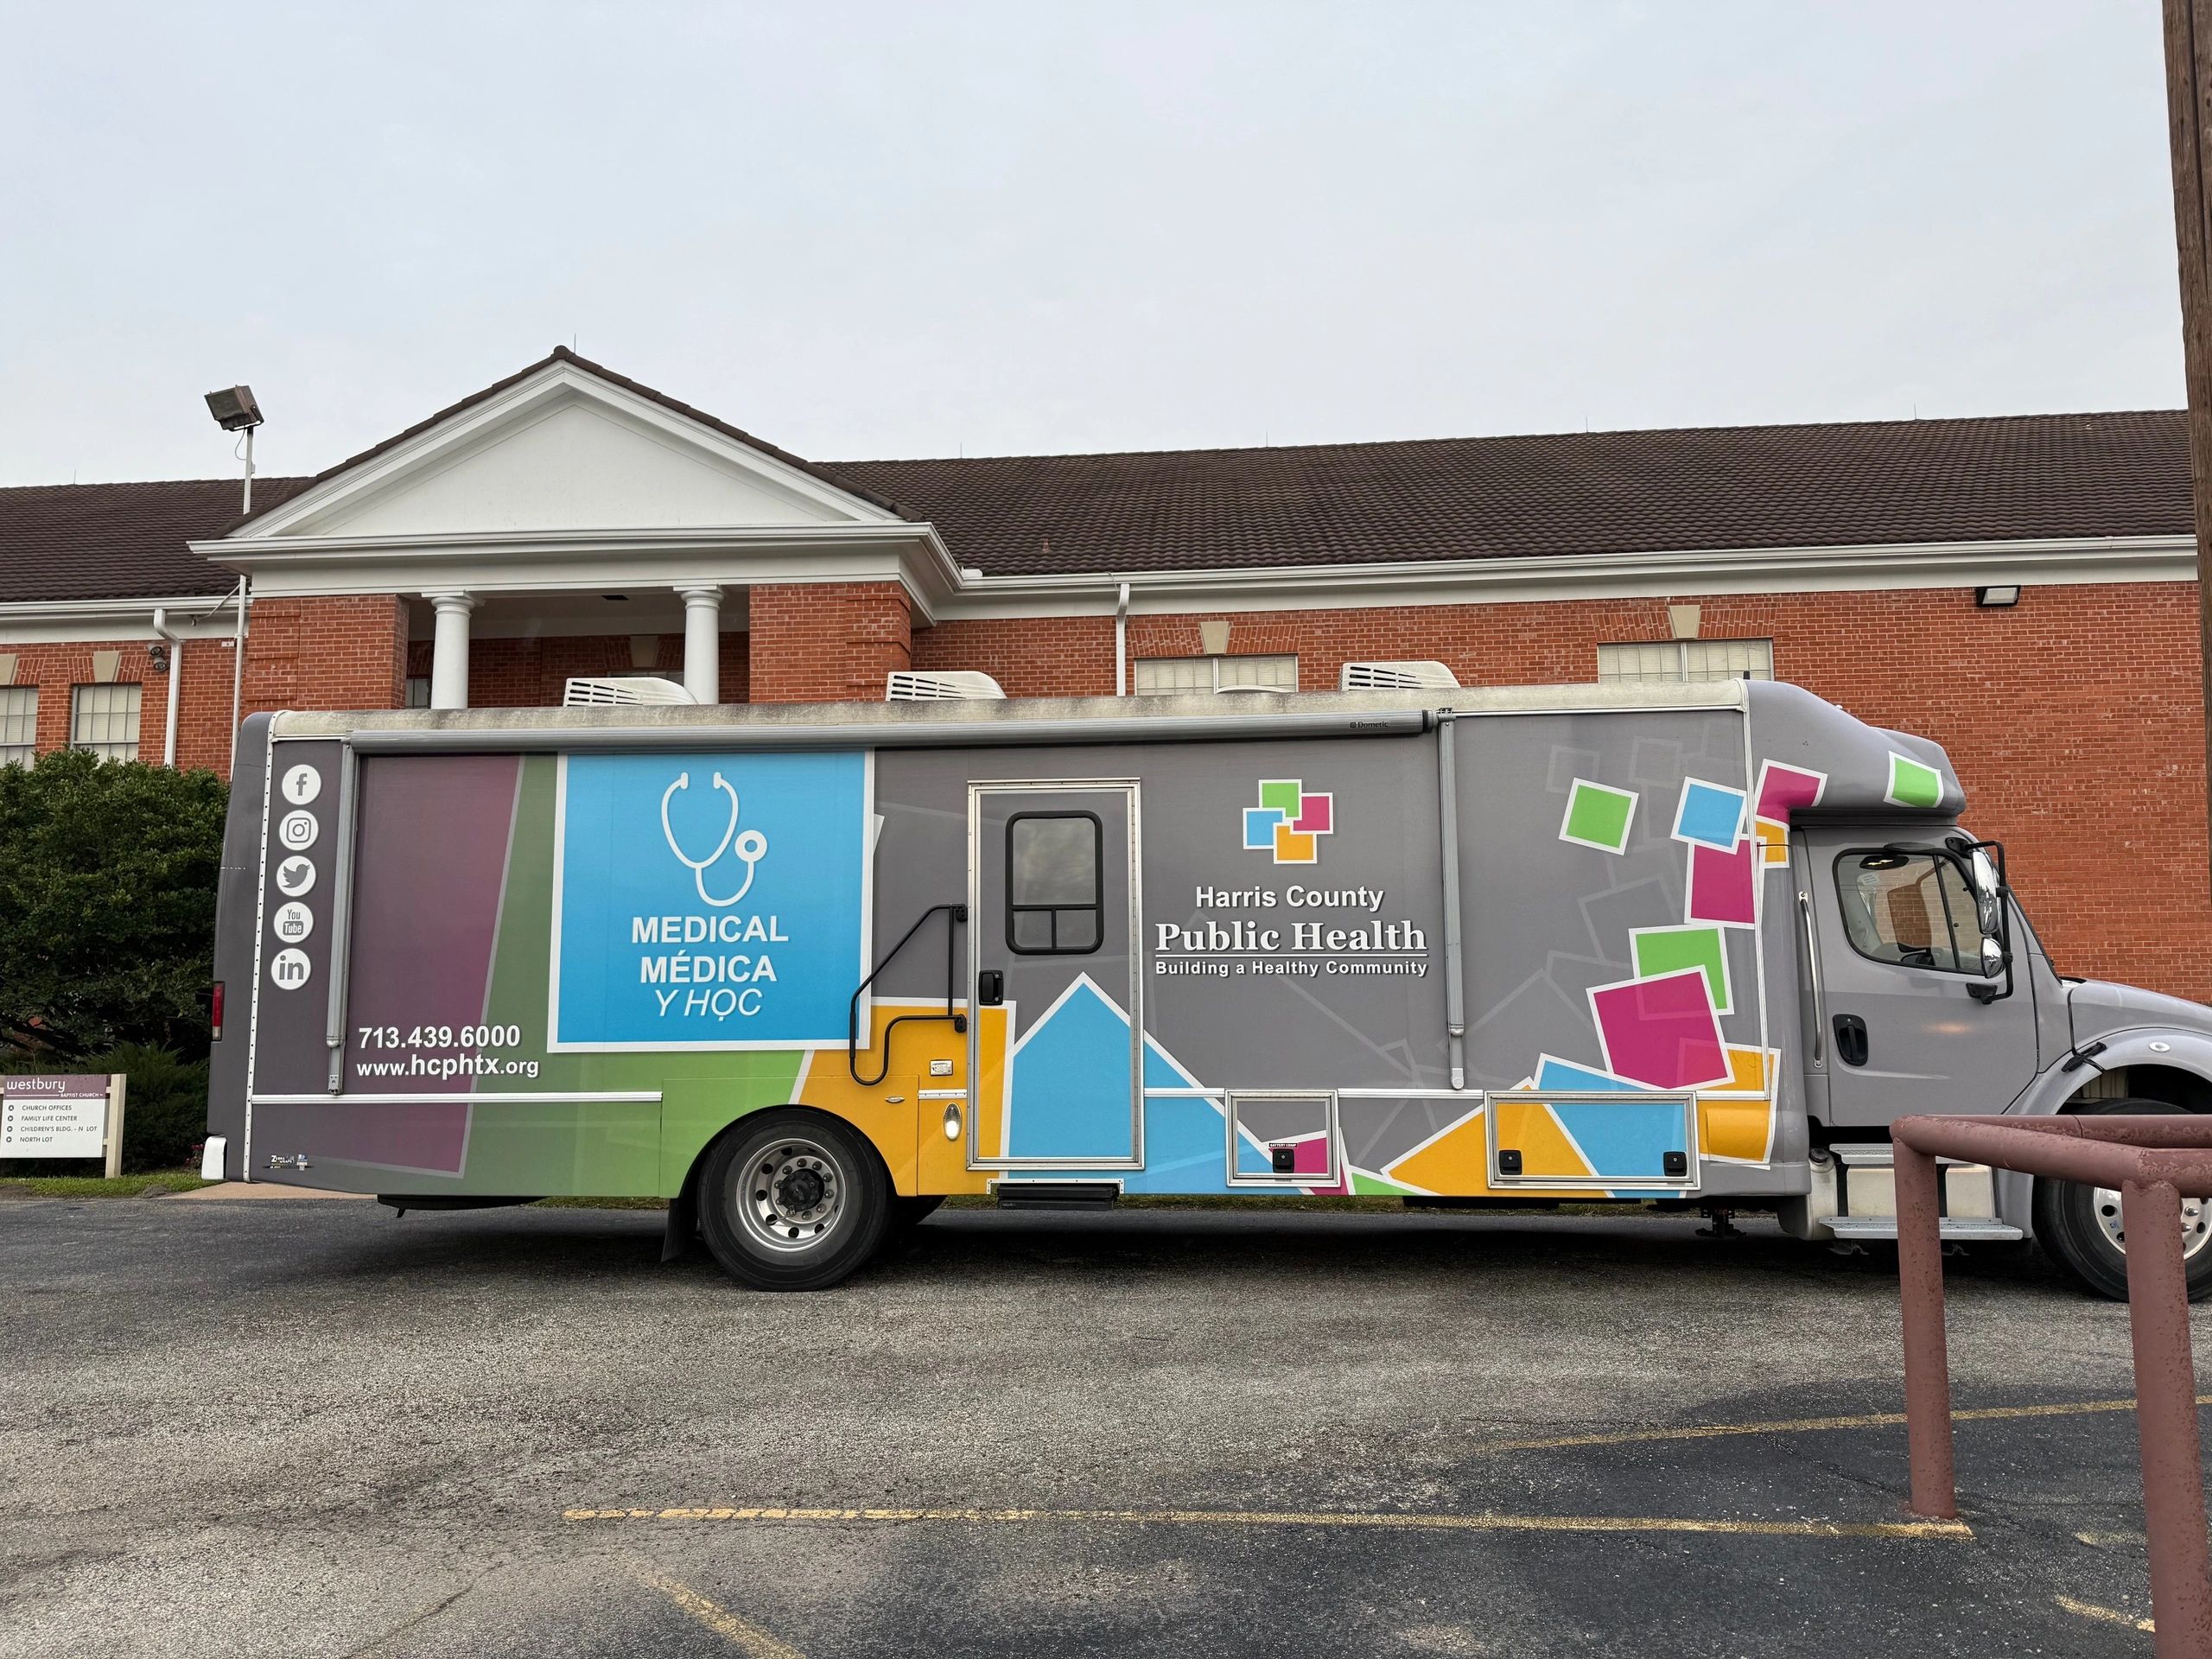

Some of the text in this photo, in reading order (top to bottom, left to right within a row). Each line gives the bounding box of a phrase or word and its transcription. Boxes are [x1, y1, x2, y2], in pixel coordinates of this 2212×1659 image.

[1196, 885, 1384, 912] Harris County
[283, 922, 302, 934] Tube
[287, 909, 301, 920] You
[632, 915, 789, 944] MEDICAL
[1154, 920, 1427, 951] Public Health
[278, 954, 304, 981] in
[640, 949, 778, 983] MÉDICA
[1155, 960, 1428, 977] Building a Healthy Community
[655, 988, 763, 1022] Y HỌC
[359, 1025, 521, 1049] 713.439.6000
[356, 1053, 539, 1080] www.hcphtx.org
[6, 1077, 66, 1093] westbury
